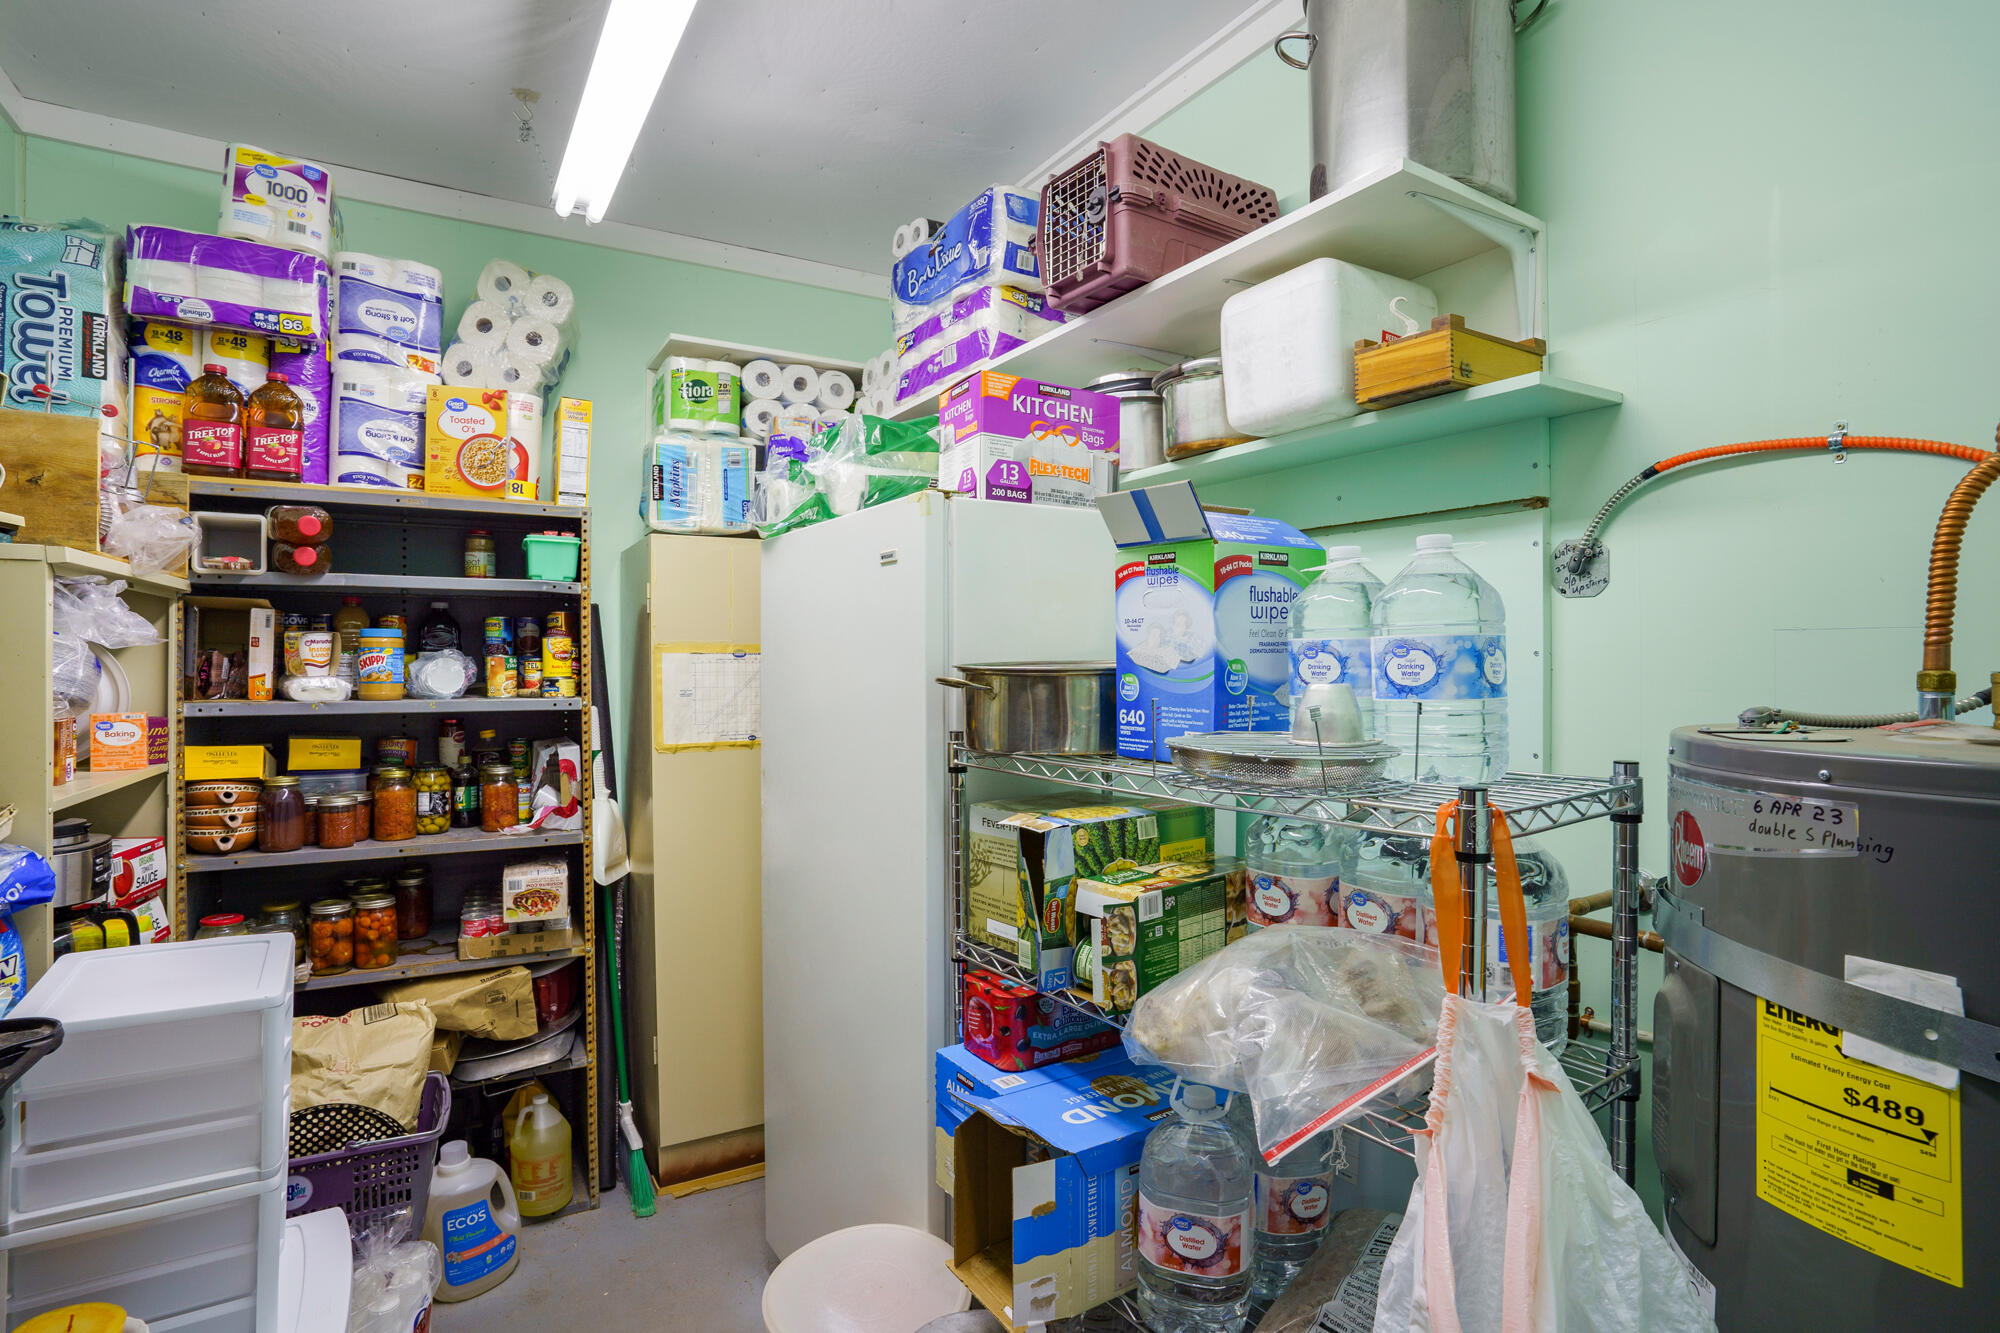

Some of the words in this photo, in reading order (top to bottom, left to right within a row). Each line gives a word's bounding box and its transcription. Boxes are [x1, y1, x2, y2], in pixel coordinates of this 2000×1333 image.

[266, 180, 308, 203] 1000
[1012, 291, 1025, 303] 96
[178, 307, 212, 319] Cottonelle
[365, 309, 390, 320] Strong
[254, 320, 280, 331] MEGA
[282, 318, 303, 331] 96
[16, 272, 68, 402] Towel
[59, 306, 73, 380] PREMIUM
[92, 316, 105, 378] KIRKLAND
[149, 365, 180, 377] Charmin
[679, 381, 714, 399] fiora
[1039, 384, 1071, 396] KIRKLAND
[151, 397, 181, 406] STRONG
[945, 398, 972, 422] KITCHEN
[1012, 393, 1093, 425] KITCHEN
[450, 415, 485, 425] Toasted
[461, 425, 476, 433] O's
[1082, 432, 1104, 446] Bags
[963, 470, 972, 484] 13
[1000, 463, 1019, 480] 13
[1029, 458, 1090, 482] FLEX-TECH
[408, 477, 424, 488] 72
[511, 482, 524, 494] 18
[669, 458, 682, 508] Napkins
[992, 488, 1006, 498] 200
[1007, 488, 1027, 499] BAGS
[1149, 552, 1175, 561] KIRKLAND
[1260, 552, 1288, 562] KIRKLAND
[1146, 565, 1180, 576] flushable
[1239, 560, 1252, 569] Packs
[1147, 575, 1179, 588] wipes
[1249, 585, 1298, 603] flushable
[1250, 605, 1289, 624] wipe
[1249, 628, 1260, 638] Feel
[1261, 628, 1277, 638] Clean
[359, 655, 386, 671] SKIPPY
[1307, 663, 1331, 672] Drinking
[1397, 663, 1424, 671] Drinking
[1119, 709, 1145, 725] 640
[1753, 800, 1763, 814] 6
[1770, 801, 1802, 817] APR
[1813, 806, 1843, 825] 23
[1673, 818, 1704, 874] Rheem
[1749, 818, 1797, 841] double
[1806, 827, 1815, 842] S
[1822, 830, 1895, 863] Plumbing
[136, 870, 158, 888] SAUCE
[1262, 894, 1281, 904] Distilled
[1356, 910, 1377, 921] Distilled
[1357, 918, 1374, 927] Water
[1053, 970, 1066, 987] 12
[1032, 1031, 1058, 1041] EXTRA
[1058, 1024, 1083, 1036] LARGE
[1790, 1053, 1821, 1069] Estimated
[1823, 1064, 1845, 1077] Yearly
[1846, 1072, 1872, 1086] Energy
[1873, 1080, 1891, 1090] Cost
[1062, 1079, 1175, 1124] LMOND
[1064, 1085, 1114, 1105] BEVERAGE
[1842, 1087, 1925, 1127] $489
[1817, 1117, 1831, 1127] Range
[1856, 1133, 1875, 1143] Models
[1816, 1140, 1832, 1151] First
[1833, 1147, 1851, 1159] Hour
[1853, 1154, 1877, 1169] Rating
[1850, 1159, 1858, 1167] the
[1301, 1196, 1320, 1206] Distilled
[447, 1209, 487, 1231] ECOS
[1120, 1179, 1133, 1271] ALMOND
[448, 1234, 465, 1243] Plant
[1179, 1234, 1205, 1246] Distilled
[1181, 1242, 1202, 1252] Water
[1322, 1312, 1348, 1332] Protein
